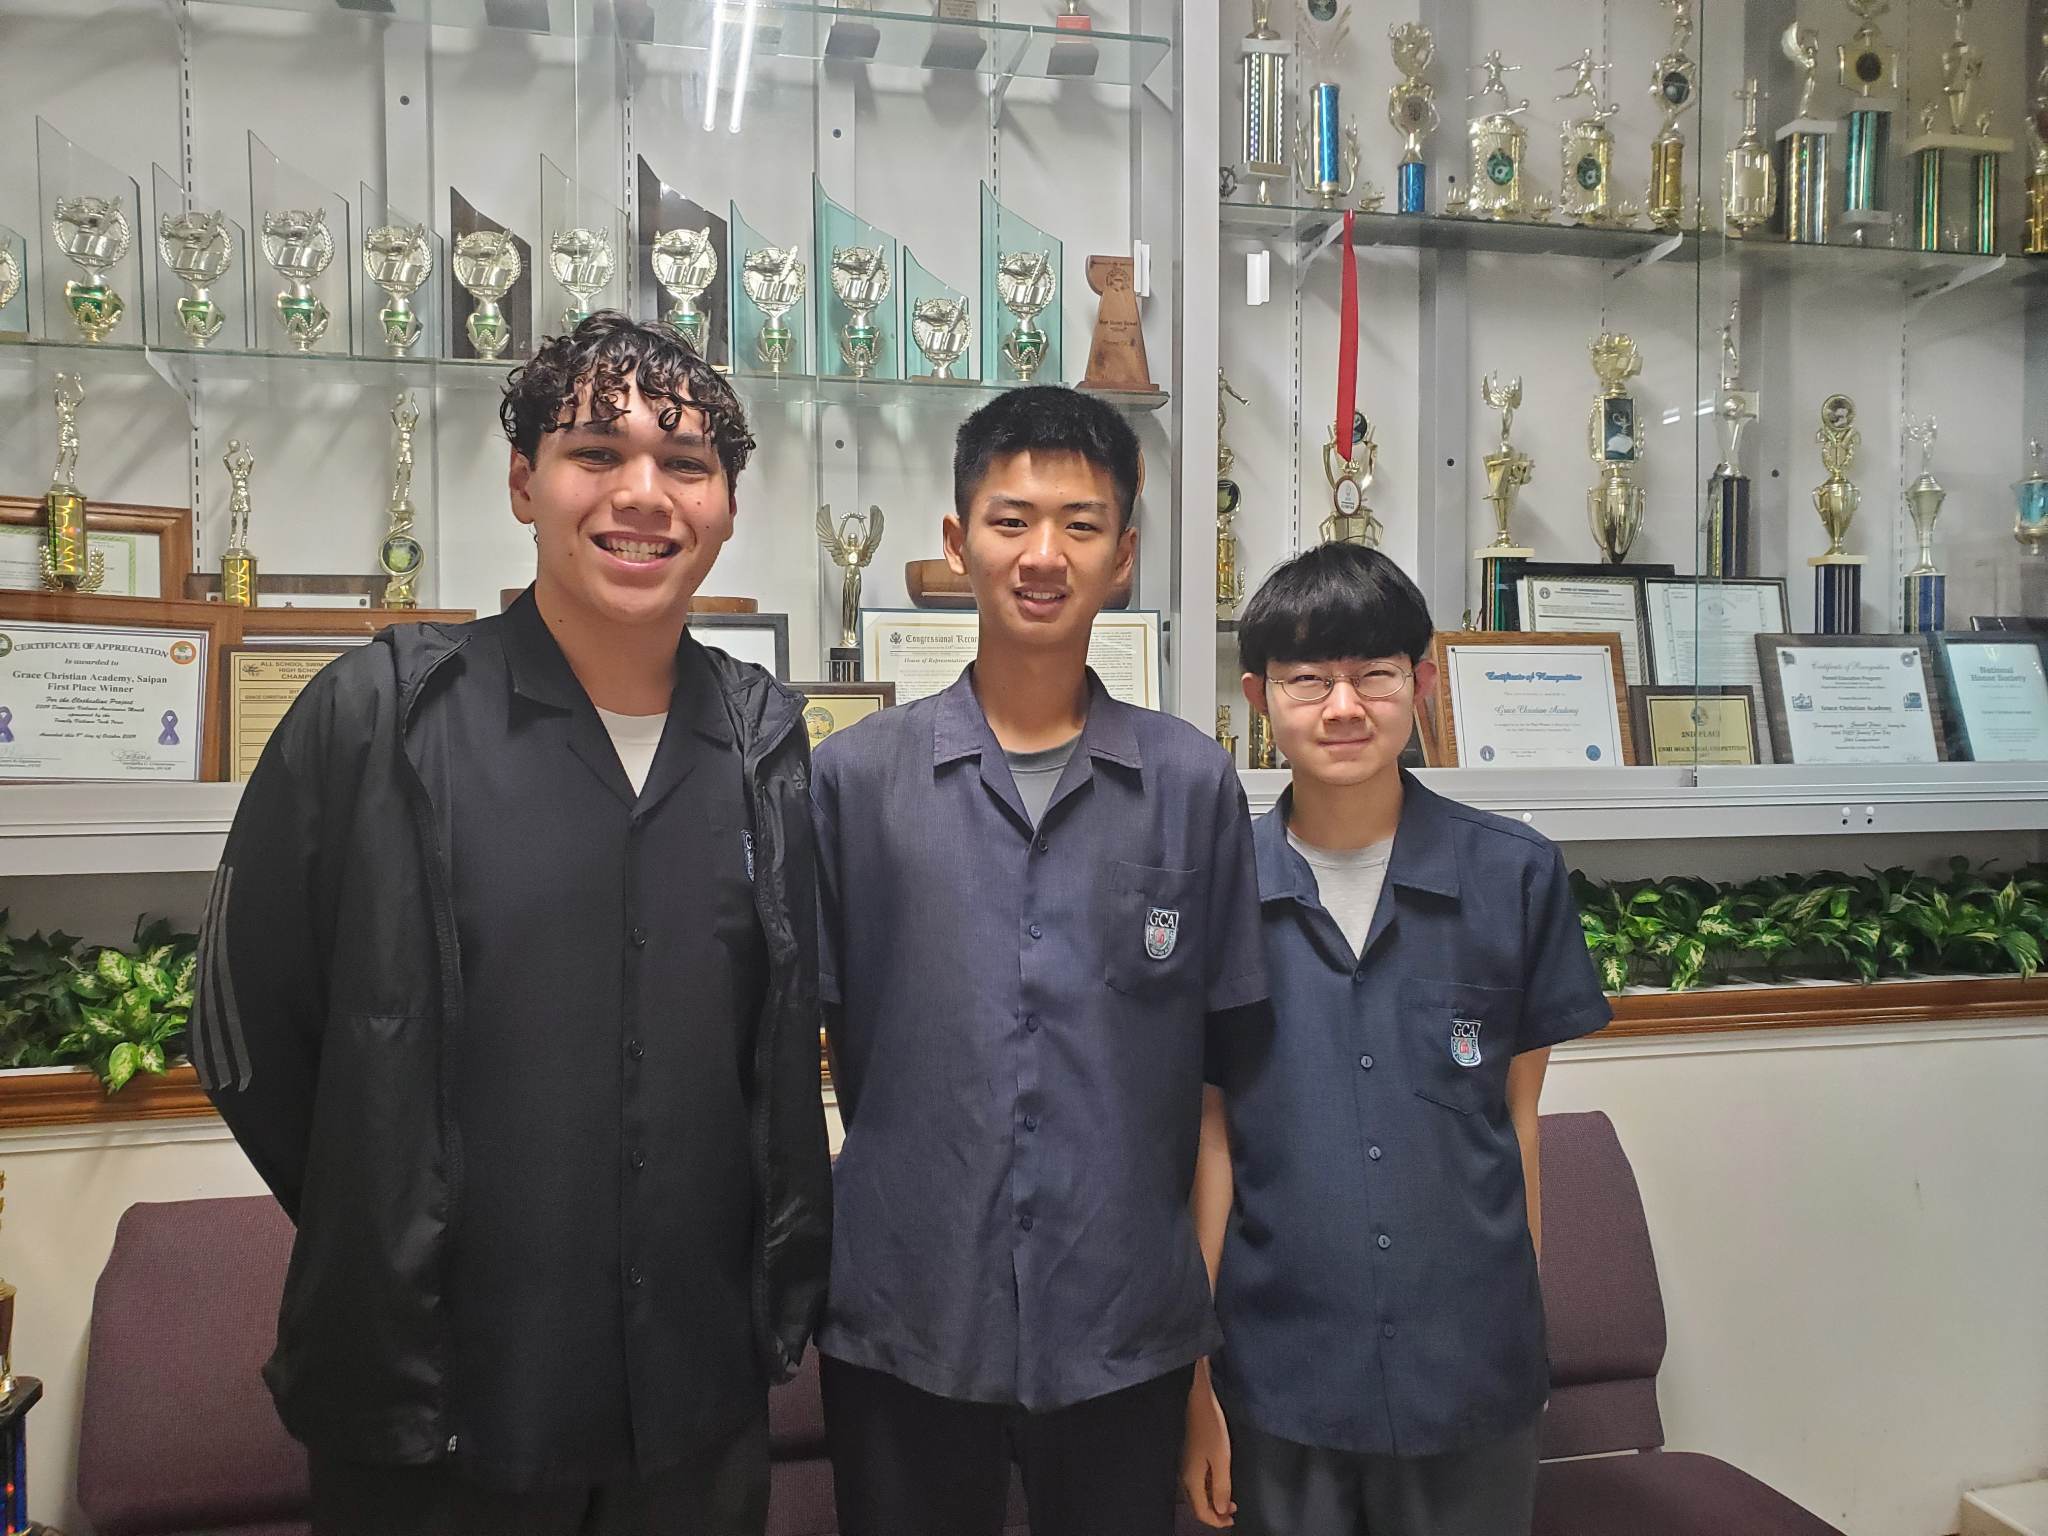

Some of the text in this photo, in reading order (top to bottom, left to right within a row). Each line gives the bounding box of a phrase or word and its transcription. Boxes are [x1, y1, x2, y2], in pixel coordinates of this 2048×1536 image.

[905, 634, 954, 644] Congressional
[14, 641, 169, 658] CERTIFICATE OF APPRECIATION
[12, 670, 168, 685] Grace Christian Academy, Saipan
[47, 682, 134, 693] First Place Winner
[1150, 911, 1176, 928] GCA
[1453, 1023, 1477, 1037] GCA
